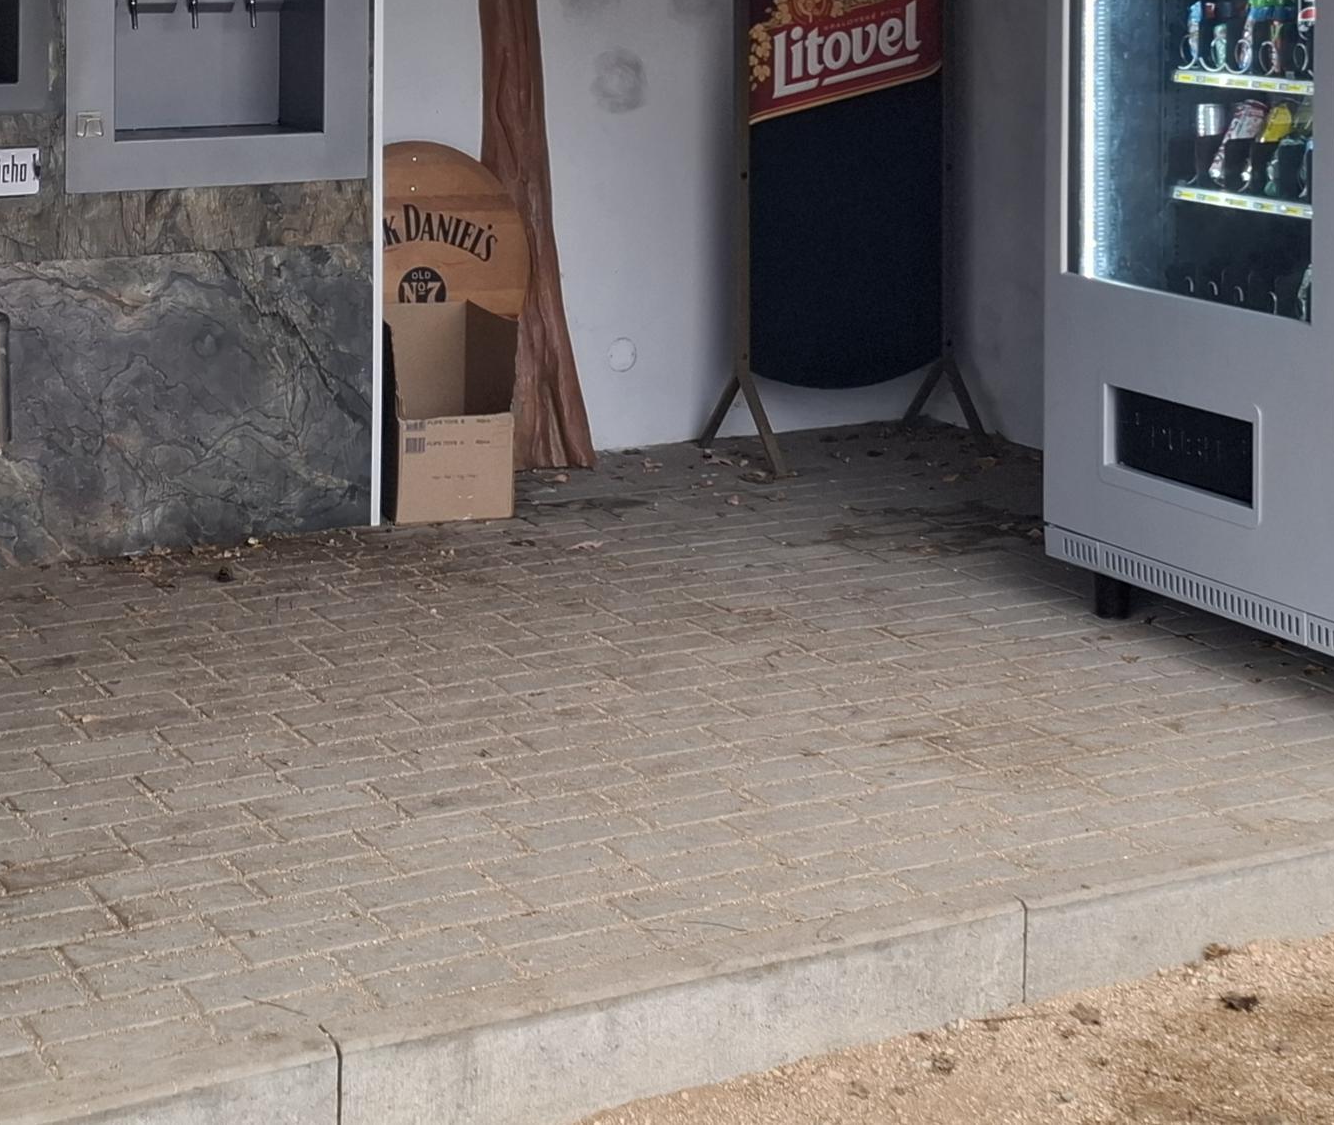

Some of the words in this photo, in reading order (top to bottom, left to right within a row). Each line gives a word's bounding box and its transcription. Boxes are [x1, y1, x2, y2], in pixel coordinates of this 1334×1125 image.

[772, 0, 923, 100] Litovel
[402, 203, 498, 263] DANIEL'S
[411, 270, 432, 281] OLD
